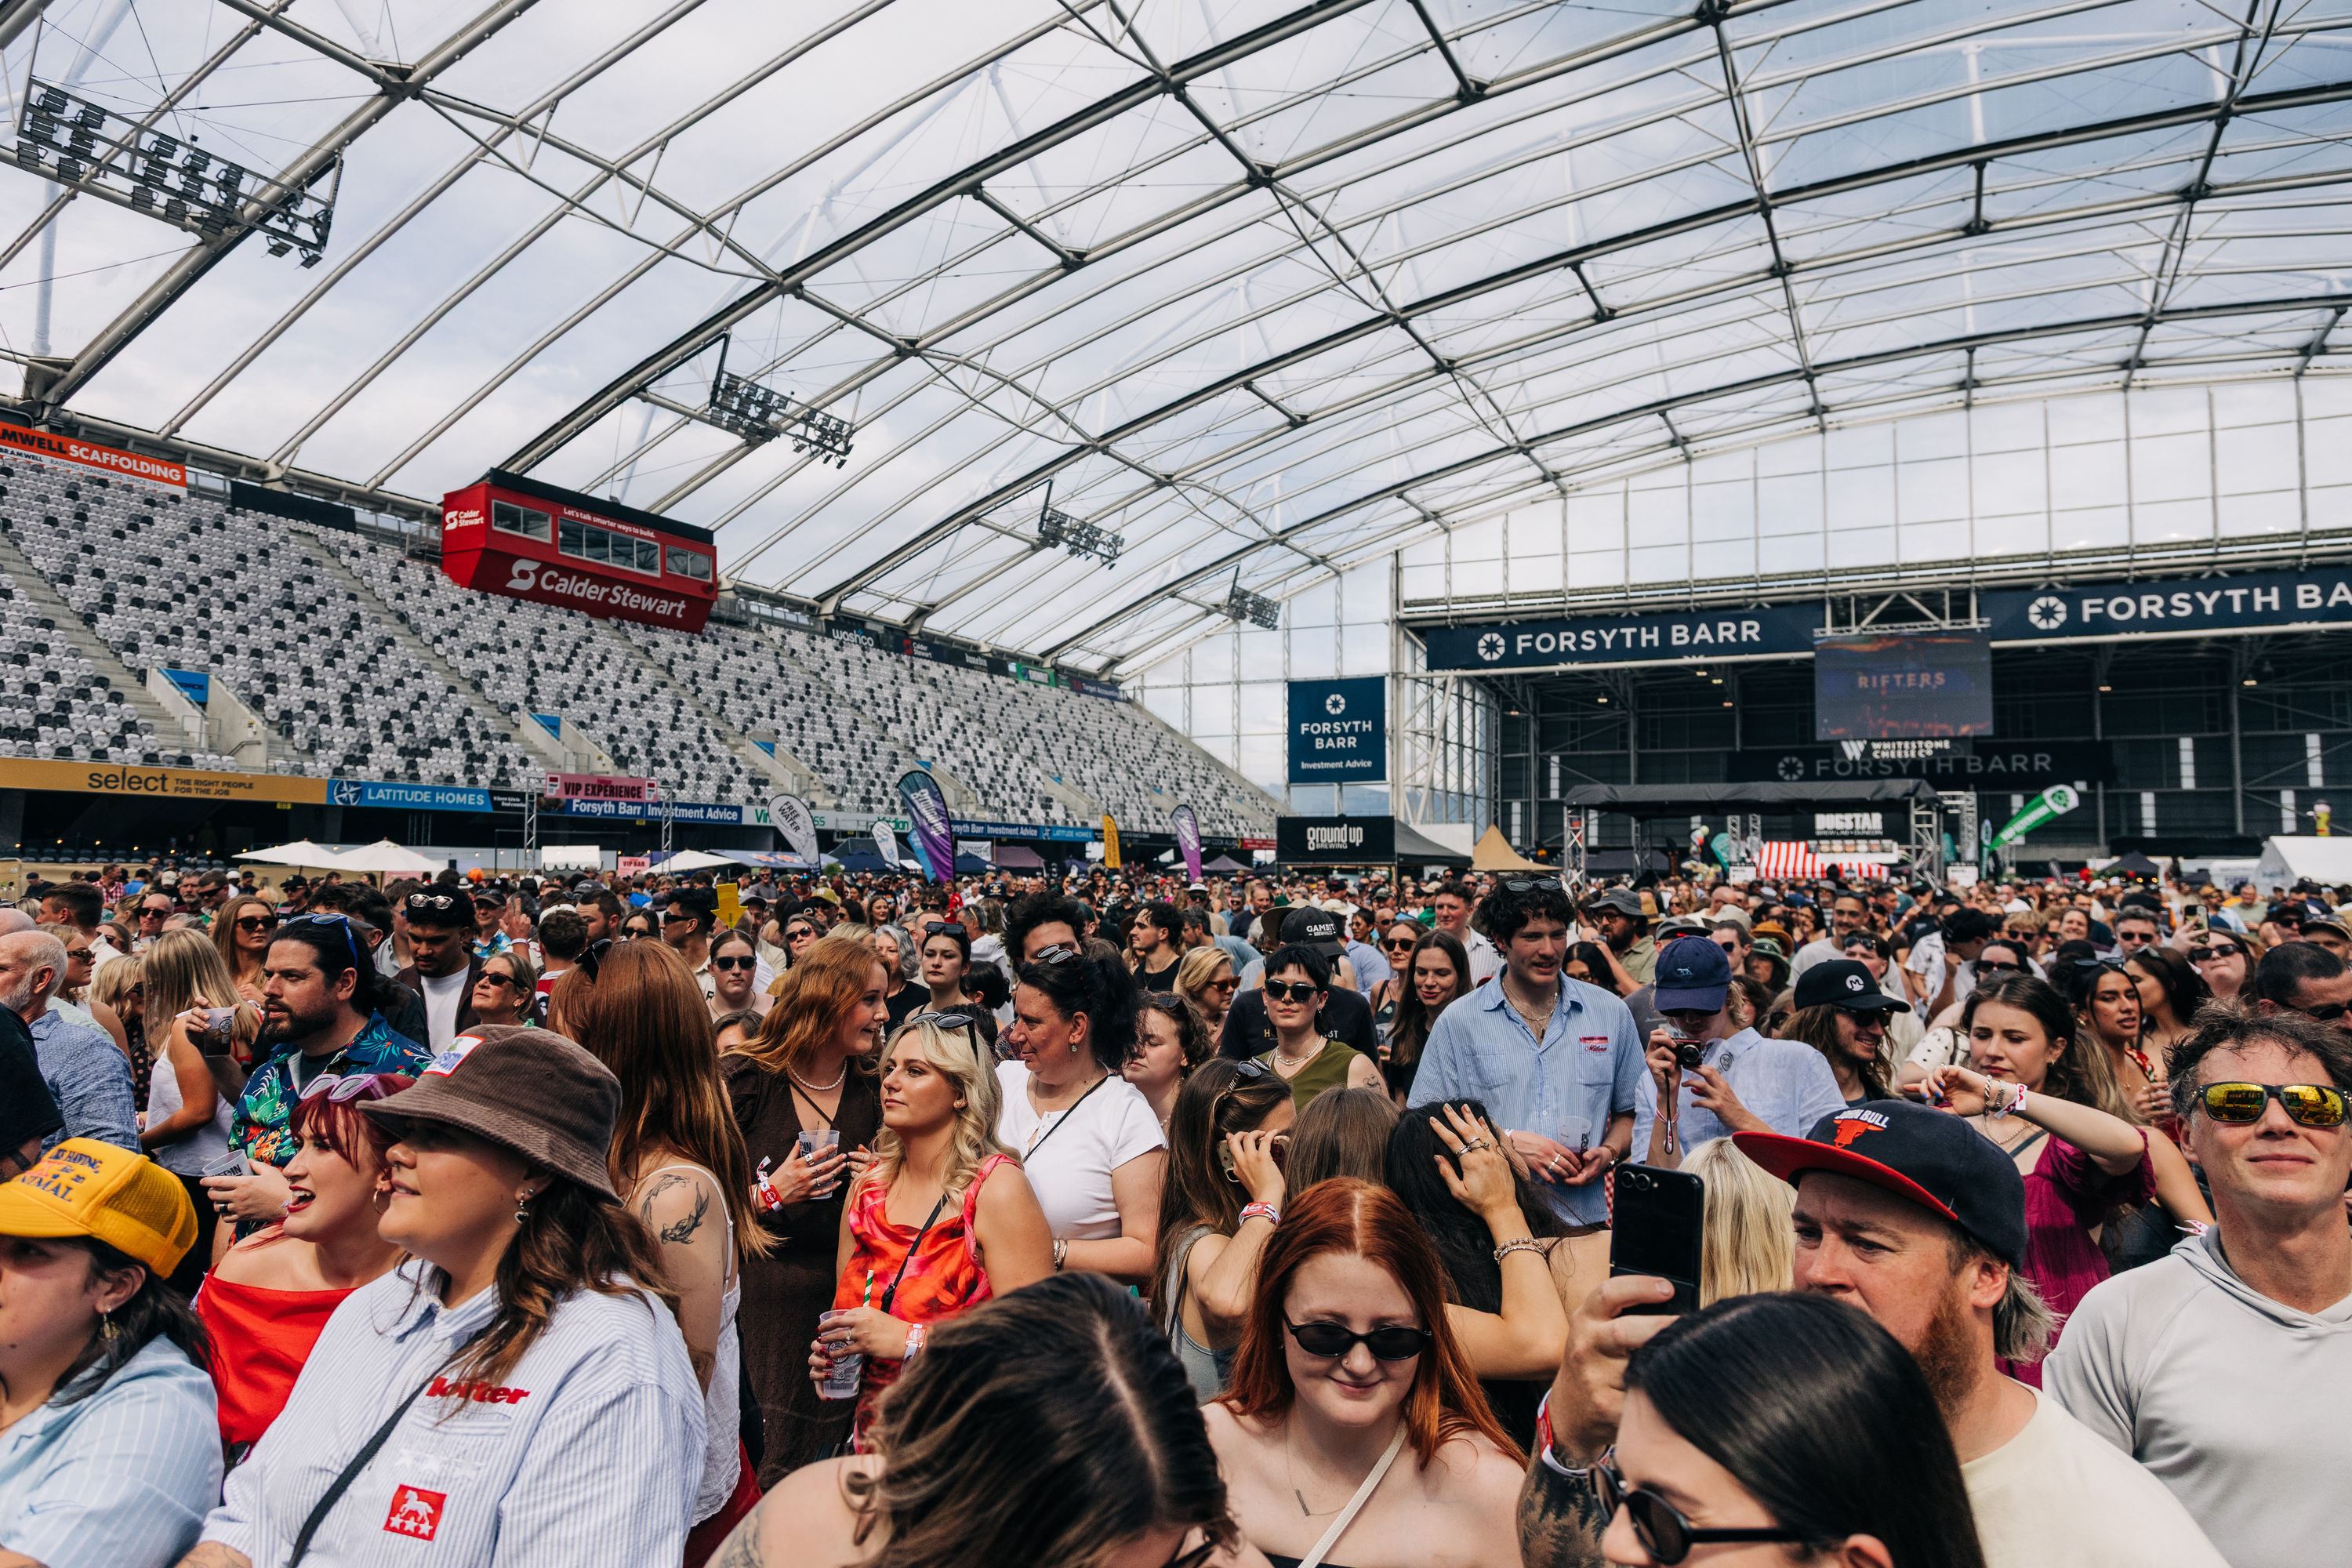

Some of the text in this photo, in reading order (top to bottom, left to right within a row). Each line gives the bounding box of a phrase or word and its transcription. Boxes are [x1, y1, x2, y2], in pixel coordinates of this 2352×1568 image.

[0, 428, 182, 481] MWELL SCAFFOLDING
[50, 458, 78, 470] RAISING
[126, 475, 148, 485] SINCE
[459, 510, 480, 519] Calder
[459, 517, 485, 527] Stewart
[563, 507, 579, 518] Let's
[580, 513, 592, 521] talk
[593, 517, 617, 528] smarter
[617, 524, 632, 533] ways
[540, 570, 687, 619] Calder Stewart
[2082, 586, 2281, 622] FORSYTH
[832, 628, 874, 648] washco
[1516, 620, 1761, 655] FORSYTH BARR
[1858, 672, 1946, 688] RIFTERS
[1301, 720, 1372, 735] FORSYTH
[1315, 736, 1357, 750] BARR
[1871, 739, 1951, 750] WHITESTONE
[1301, 759, 1373, 769] Investment Advice
[1816, 753, 2052, 776] FORSYTH BARR
[87, 768, 169, 792] select
[194, 779, 220, 788] RIGHT
[221, 780, 254, 789] PEOPLE
[368, 788, 485, 806] LATITUDE HOMES
[564, 782, 642, 799] VIP EXPERIENCE
[572, 799, 615, 816] Forsyth
[618, 801, 642, 816] Barr
[648, 803, 704, 820] Investment
[706, 806, 739, 821] Advice
[778, 806, 800, 833] WATER
[784, 800, 800, 819] FREE
[952, 824, 1037, 837] orsyth Barr Investment Advice
[1306, 823, 1363, 851] ground up
[1306, 924, 1336, 933] GAMBIT
[1860, 1109, 1889, 1129] BULL
